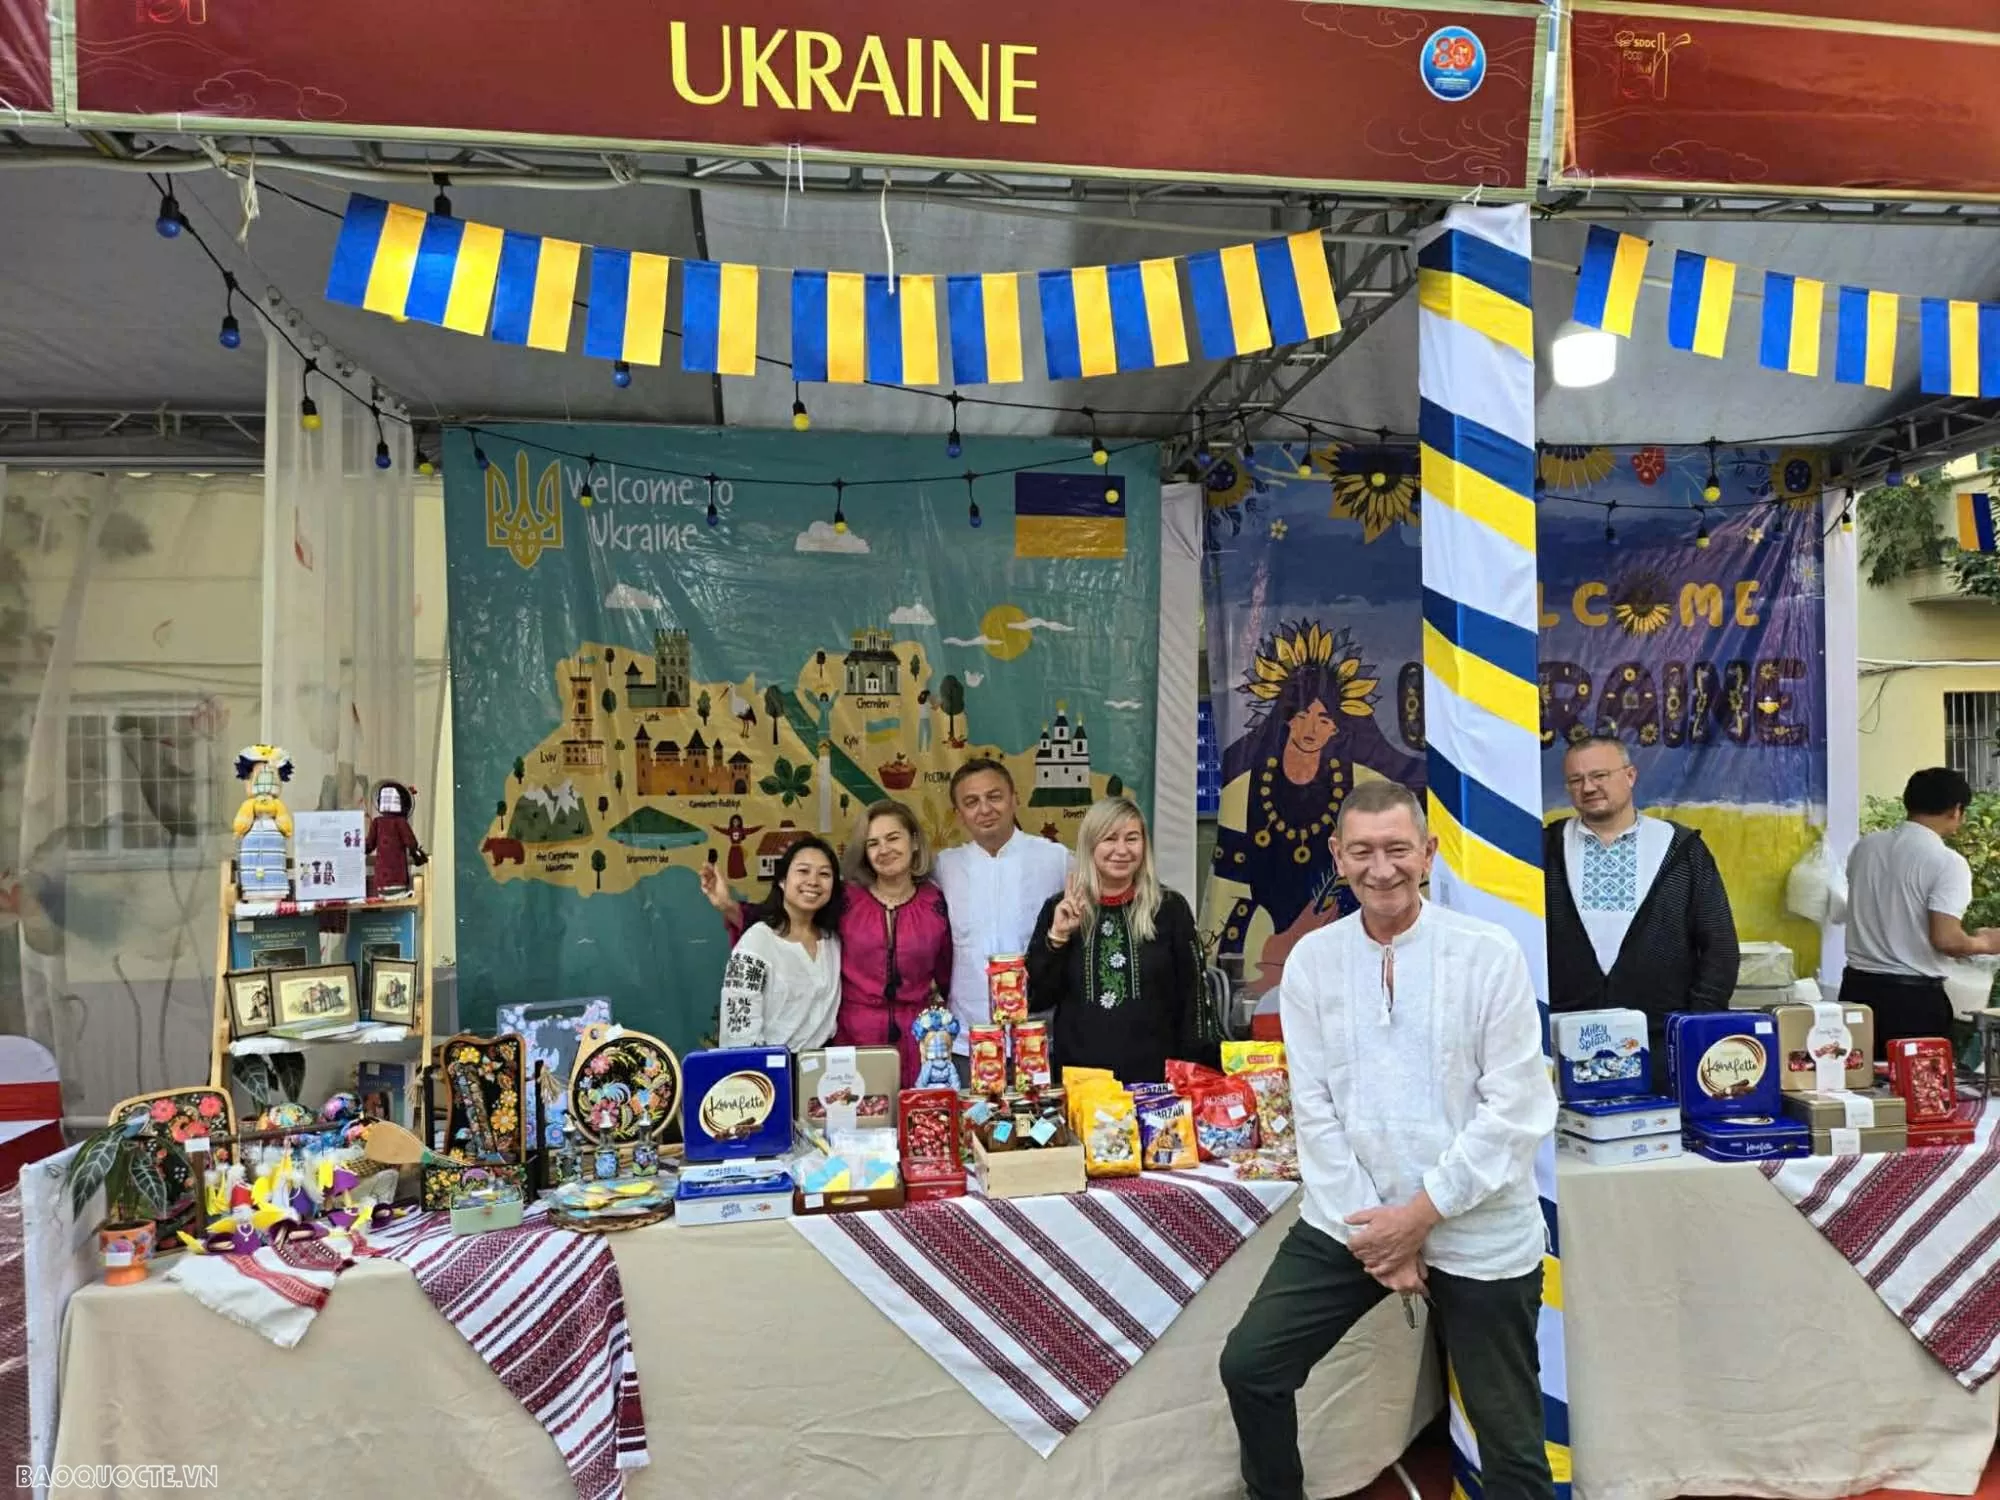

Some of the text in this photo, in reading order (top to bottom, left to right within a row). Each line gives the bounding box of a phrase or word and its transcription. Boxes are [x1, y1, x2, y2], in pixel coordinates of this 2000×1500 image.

[670, 21, 1038, 124] UKRAINE
[566, 464, 694, 505] Welcome
[591, 508, 698, 552] Ukraine
[539, 752, 557, 763] Lviv
[1579, 1033, 1612, 1051] Splash
[1580, 1023, 1608, 1037] Milky
[1707, 1057, 1758, 1081] Konafetto
[708, 1095, 765, 1119] Konafetto
